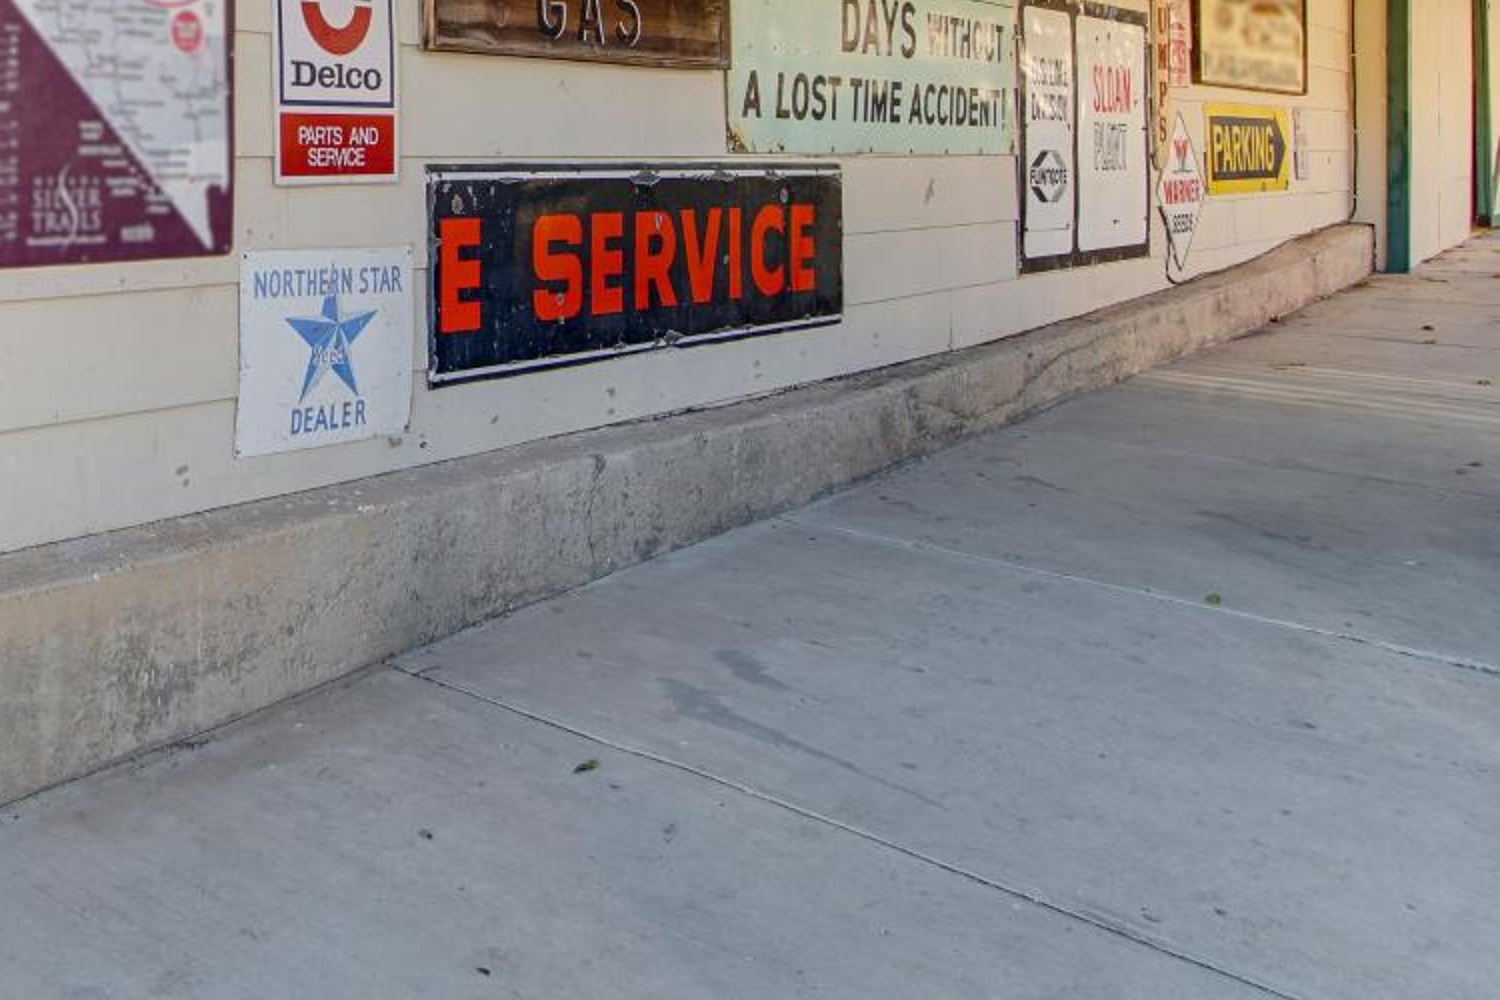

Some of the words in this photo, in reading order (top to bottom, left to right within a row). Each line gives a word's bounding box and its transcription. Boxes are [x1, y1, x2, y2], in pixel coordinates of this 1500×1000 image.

[926, 12, 1005, 64] WITHOUT
[291, 60, 382, 91] Delco
[1092, 63, 1131, 113] SLOAN
[741, 69, 762, 119] A
[775, 71, 842, 121] LOST
[850, 77, 903, 124] TIME
[908, 83, 1009, 129] ACCIDENT!
[297, 125, 343, 145] PARTS
[350, 127, 379, 145] AND
[1212, 123, 1276, 173] PARKING
[307, 147, 366, 167] SERVICE
[1162, 179, 1200, 205] WARNER
[252, 266, 353, 299] NORTHERN
[359, 265, 403, 294] STAR
[438, 217, 483, 334] E
[532, 203, 817, 322] SERVICE
[290, 400, 367, 436] DEALER
